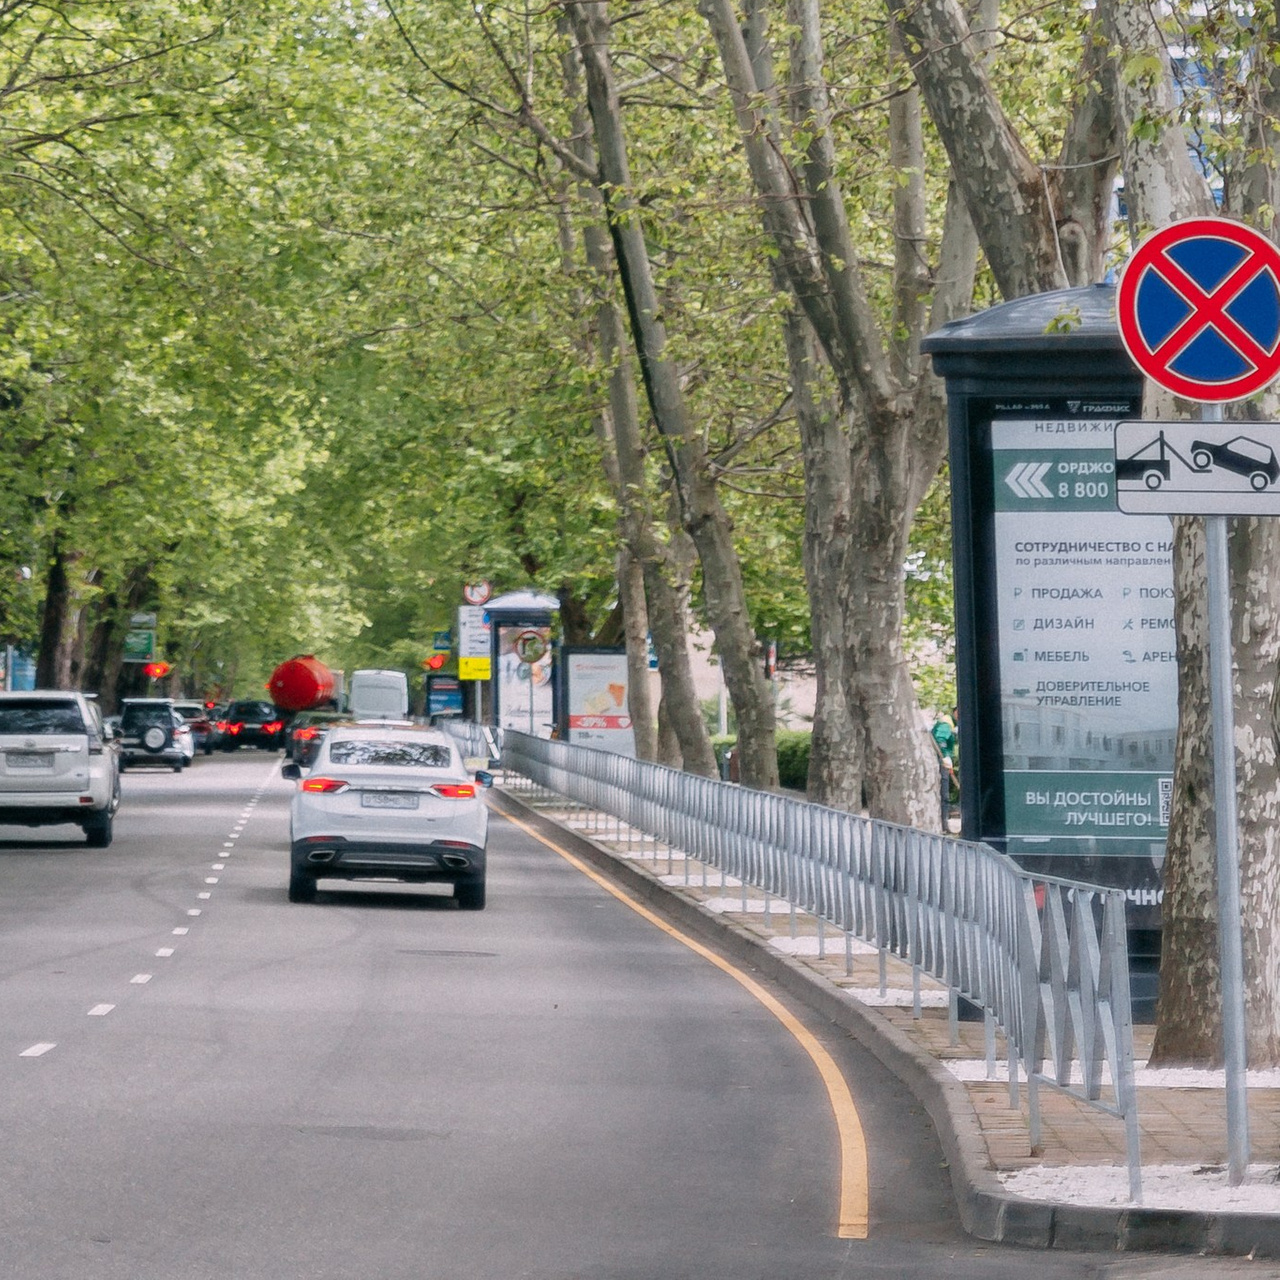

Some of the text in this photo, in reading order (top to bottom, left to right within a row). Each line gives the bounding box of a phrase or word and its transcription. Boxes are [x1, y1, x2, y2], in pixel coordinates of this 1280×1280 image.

[1034, 423, 1113, 434] НЕДВИЖИ
[1057, 462, 1114, 475] ОРДЖО
[1058, 482, 1109, 498] 8 800
[1014, 541, 1141, 554] СОТРУДНИЧЕСТВО
[1145, 541, 1154, 553] С
[1015, 558, 1030, 566] по
[1034, 558, 1102, 568] различным
[1031, 588, 1103, 600] ПРОДАЖА
[1033, 616, 1095, 631] ДИЗАЙН
[1034, 651, 1090, 662] МЕБЕЛЬ
[1035, 681, 1150, 693] ДОВЕРИТЕЛЬНОЕ
[1036, 696, 1122, 707] УПРАВЛЕНИЕ
[1025, 790, 1152, 807] ВЫ ДОСТОЙНЫ
[1064, 812, 1152, 827] ЛУЧШЕГО!
